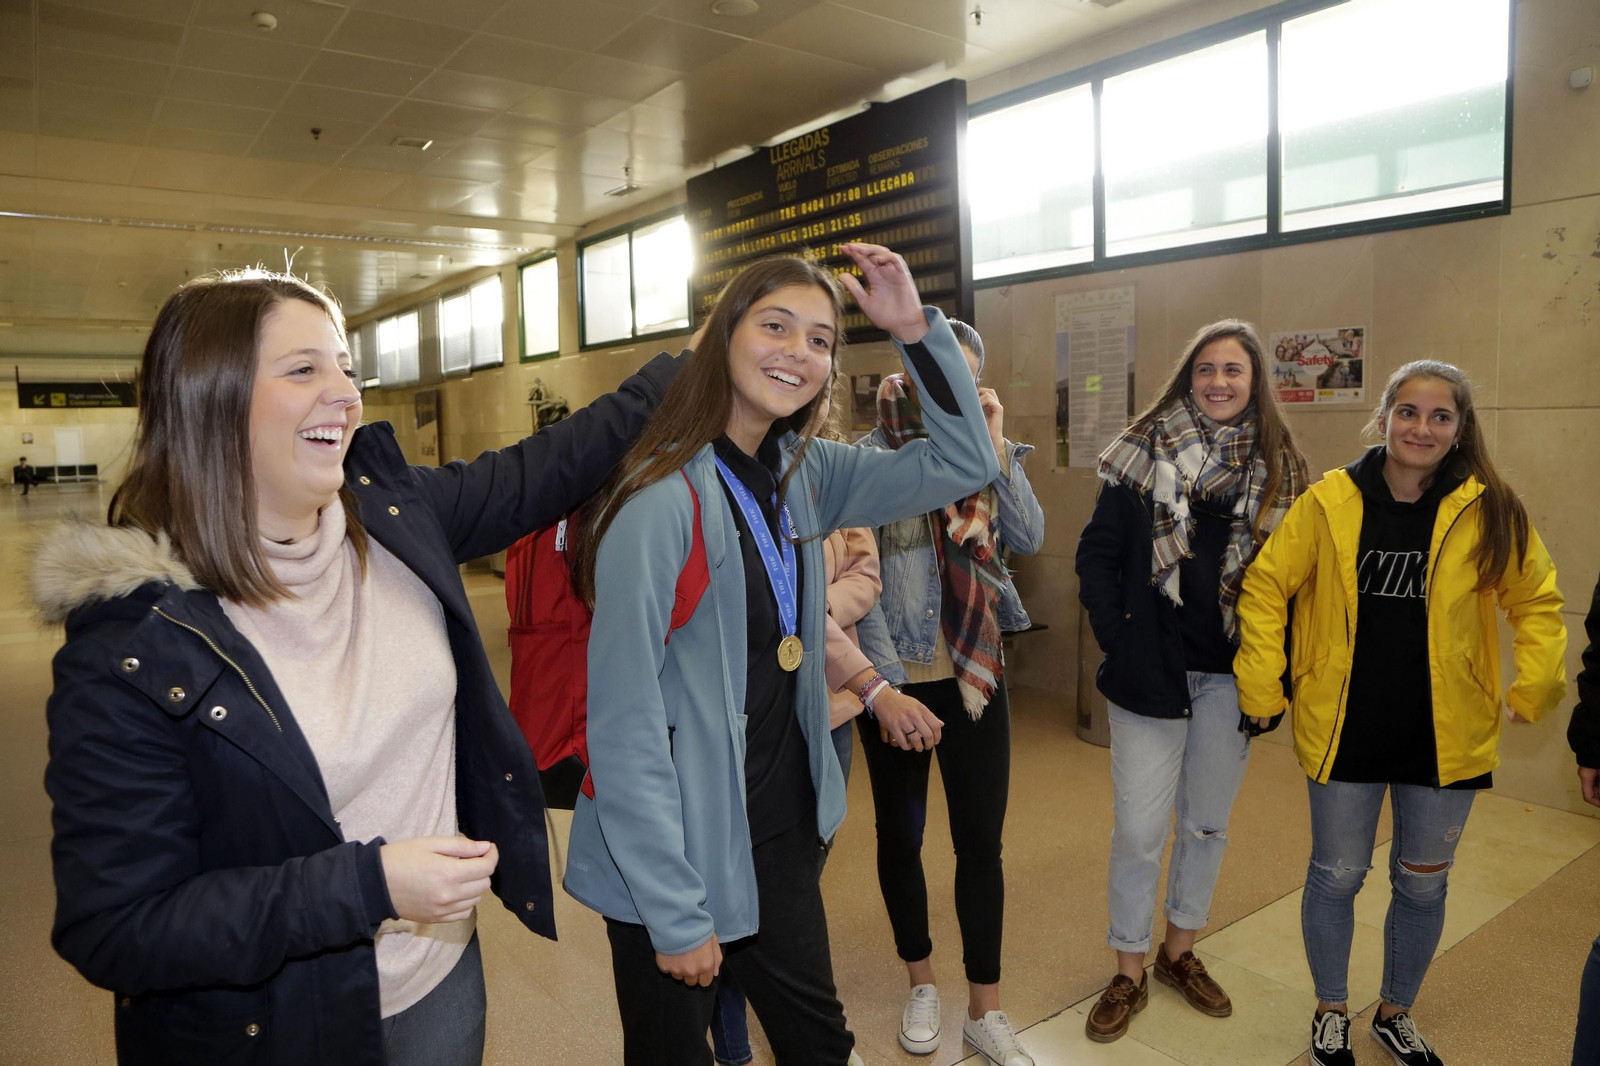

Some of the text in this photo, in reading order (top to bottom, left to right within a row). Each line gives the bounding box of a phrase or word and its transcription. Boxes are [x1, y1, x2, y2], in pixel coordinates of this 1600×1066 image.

[770, 127, 830, 164] LLEGADAS
[868, 136, 929, 164] OBSERVACIONES
[776, 149, 826, 181] ARRIVALS
[801, 198, 825, 215] 0404
[830, 187, 861, 207] 17:00
[867, 171, 915, 196] LLEGADA
[781, 230, 797, 244] VLG
[802, 222, 825, 240] 3153
[831, 213, 862, 232] 21:35
[1297, 354, 1334, 367] Safety
